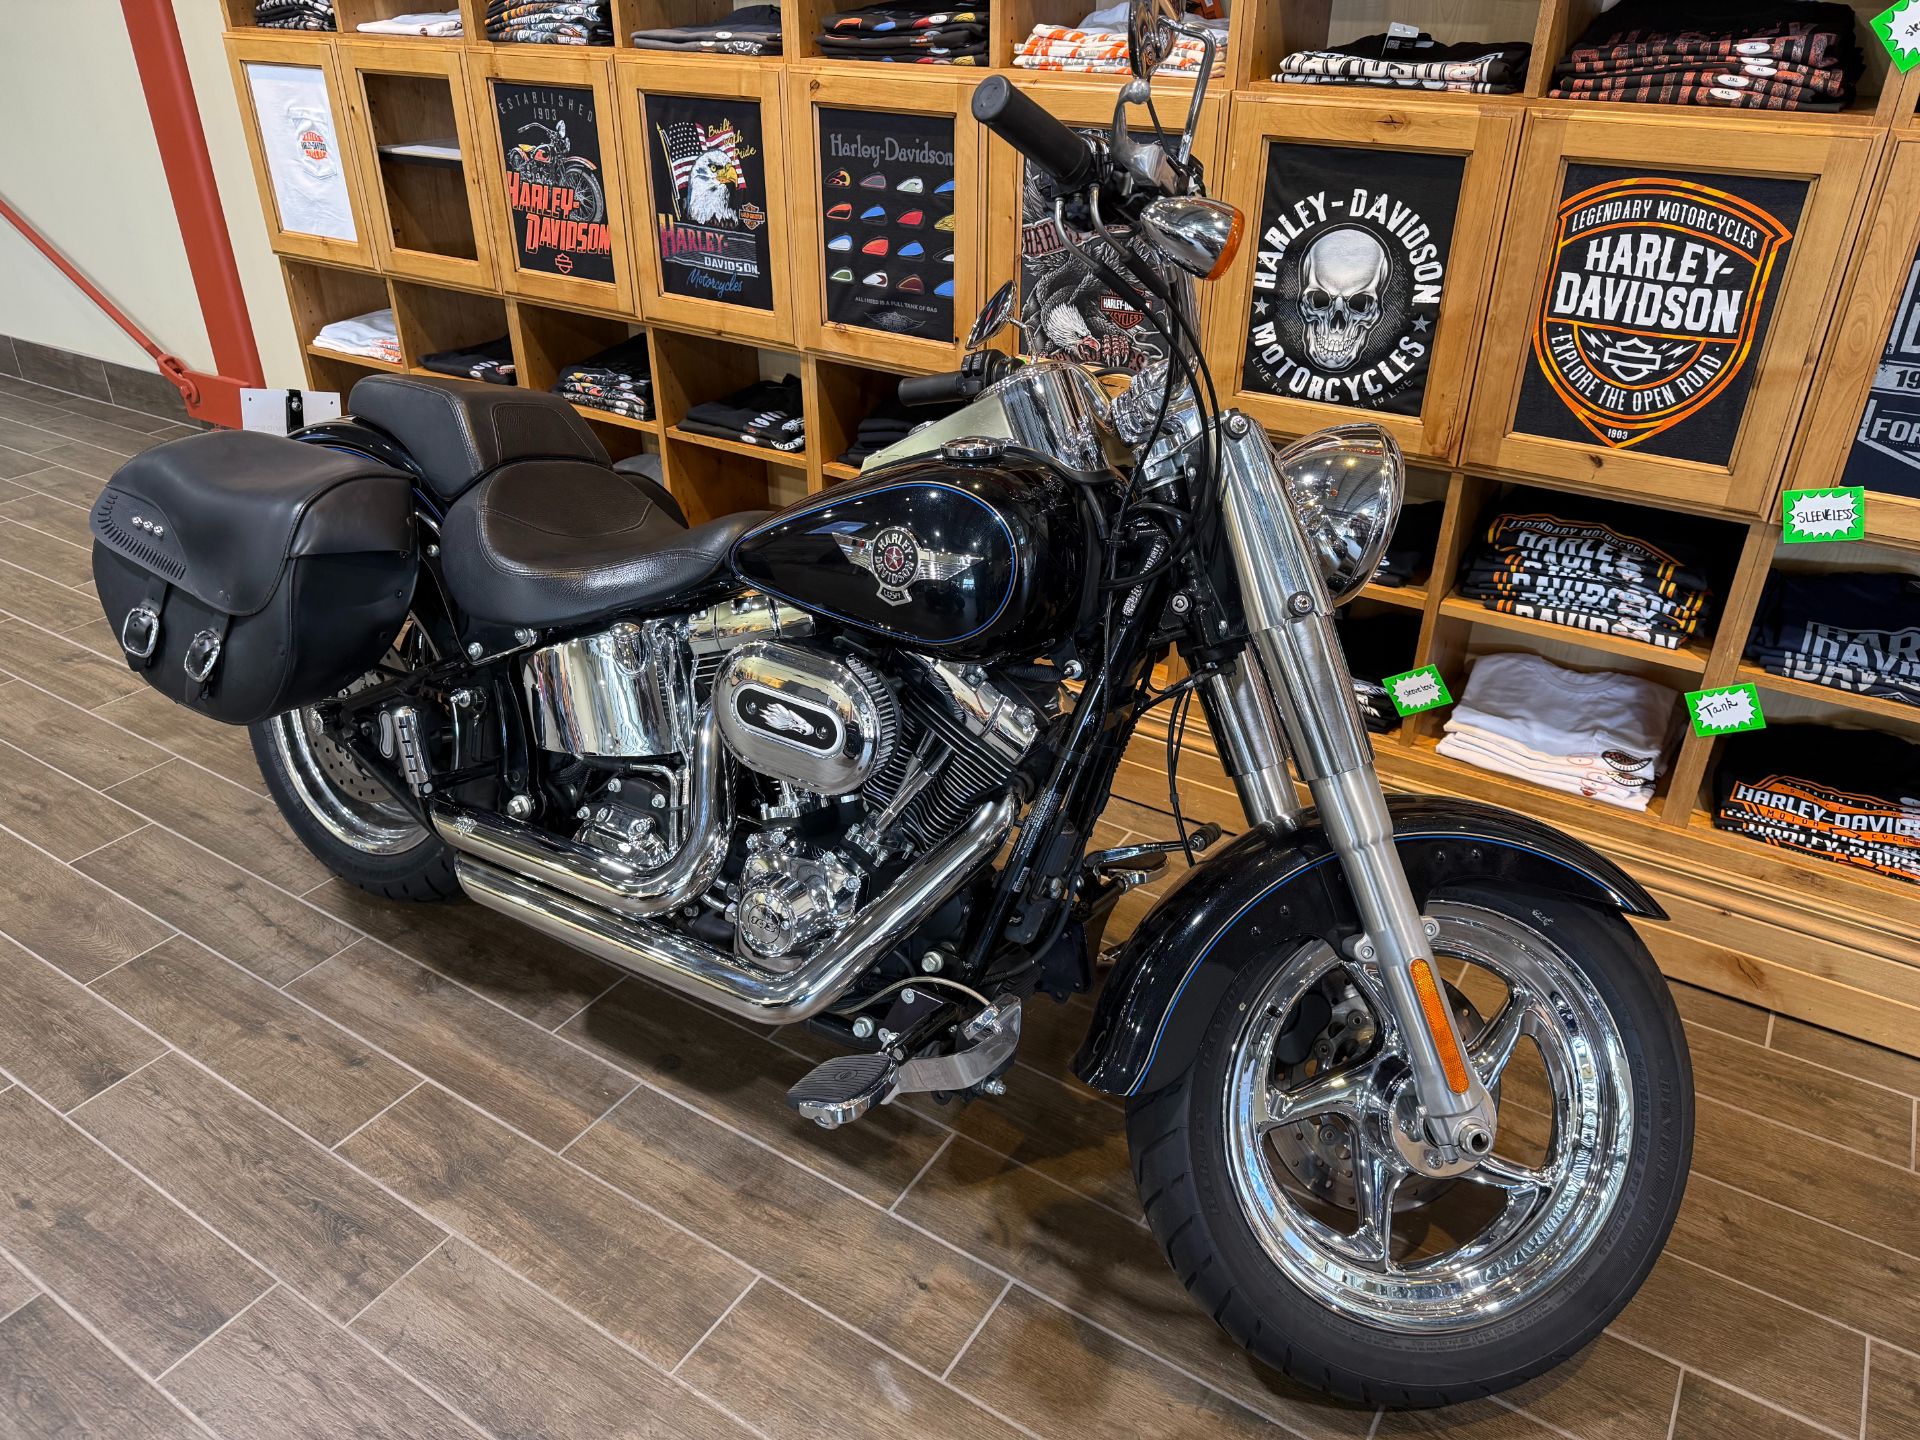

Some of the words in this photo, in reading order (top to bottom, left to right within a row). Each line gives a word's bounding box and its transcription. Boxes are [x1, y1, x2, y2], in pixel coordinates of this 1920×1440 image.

[499, 91, 593, 122] ESTABLISHED
[533, 107, 557, 121] 1903
[708, 118, 732, 137] Built
[724, 133, 744, 148] with
[830, 133, 953, 168] Harley-Davidson
[733, 145, 757, 161] Pride
[506, 171, 580, 218] HARLEY-
[525, 213, 611, 255] DAVIDSON
[658, 213, 729, 258] HARLEY-
[1571, 199, 1652, 233] LEGENDARY
[1656, 200, 1758, 250] MOTORCYCLES
[1253, 188, 1443, 304] HARLEY-DAVIDSON
[704, 256, 760, 275] DAVIDSON
[1584, 233, 1735, 284] HARLEY-
[687, 269, 742, 297] Motorcycles
[904, 302, 918, 310] TANK
[1553, 271, 1743, 334] DAVIDSON
[1113, 312, 1142, 326] CYCLES
[1251, 356, 1271, 383] LIVE
[1252, 321, 1425, 402] MOTORCYCLES
[1551, 332, 1602, 398] EXPLORE
[1598, 384, 1627, 412] THE
[1632, 384, 1677, 413] OPEN
[1675, 353, 1722, 397] ROAD
[1389, 378, 1414, 399] LIVE
[1607, 428, 1628, 440] 1903
[1797, 509, 1853, 523] SLEEVELESS
[1509, 521, 1578, 536] LEGENDARY
[878, 533, 914, 554] HARLEY
[875, 556, 914, 584] DAVIDSON
[883, 589, 901, 600] USA
[1699, 698, 1738, 718] Tank
[1767, 809, 1819, 827] MOTOR
[1599, 1200, 1632, 1256] RADIAL
